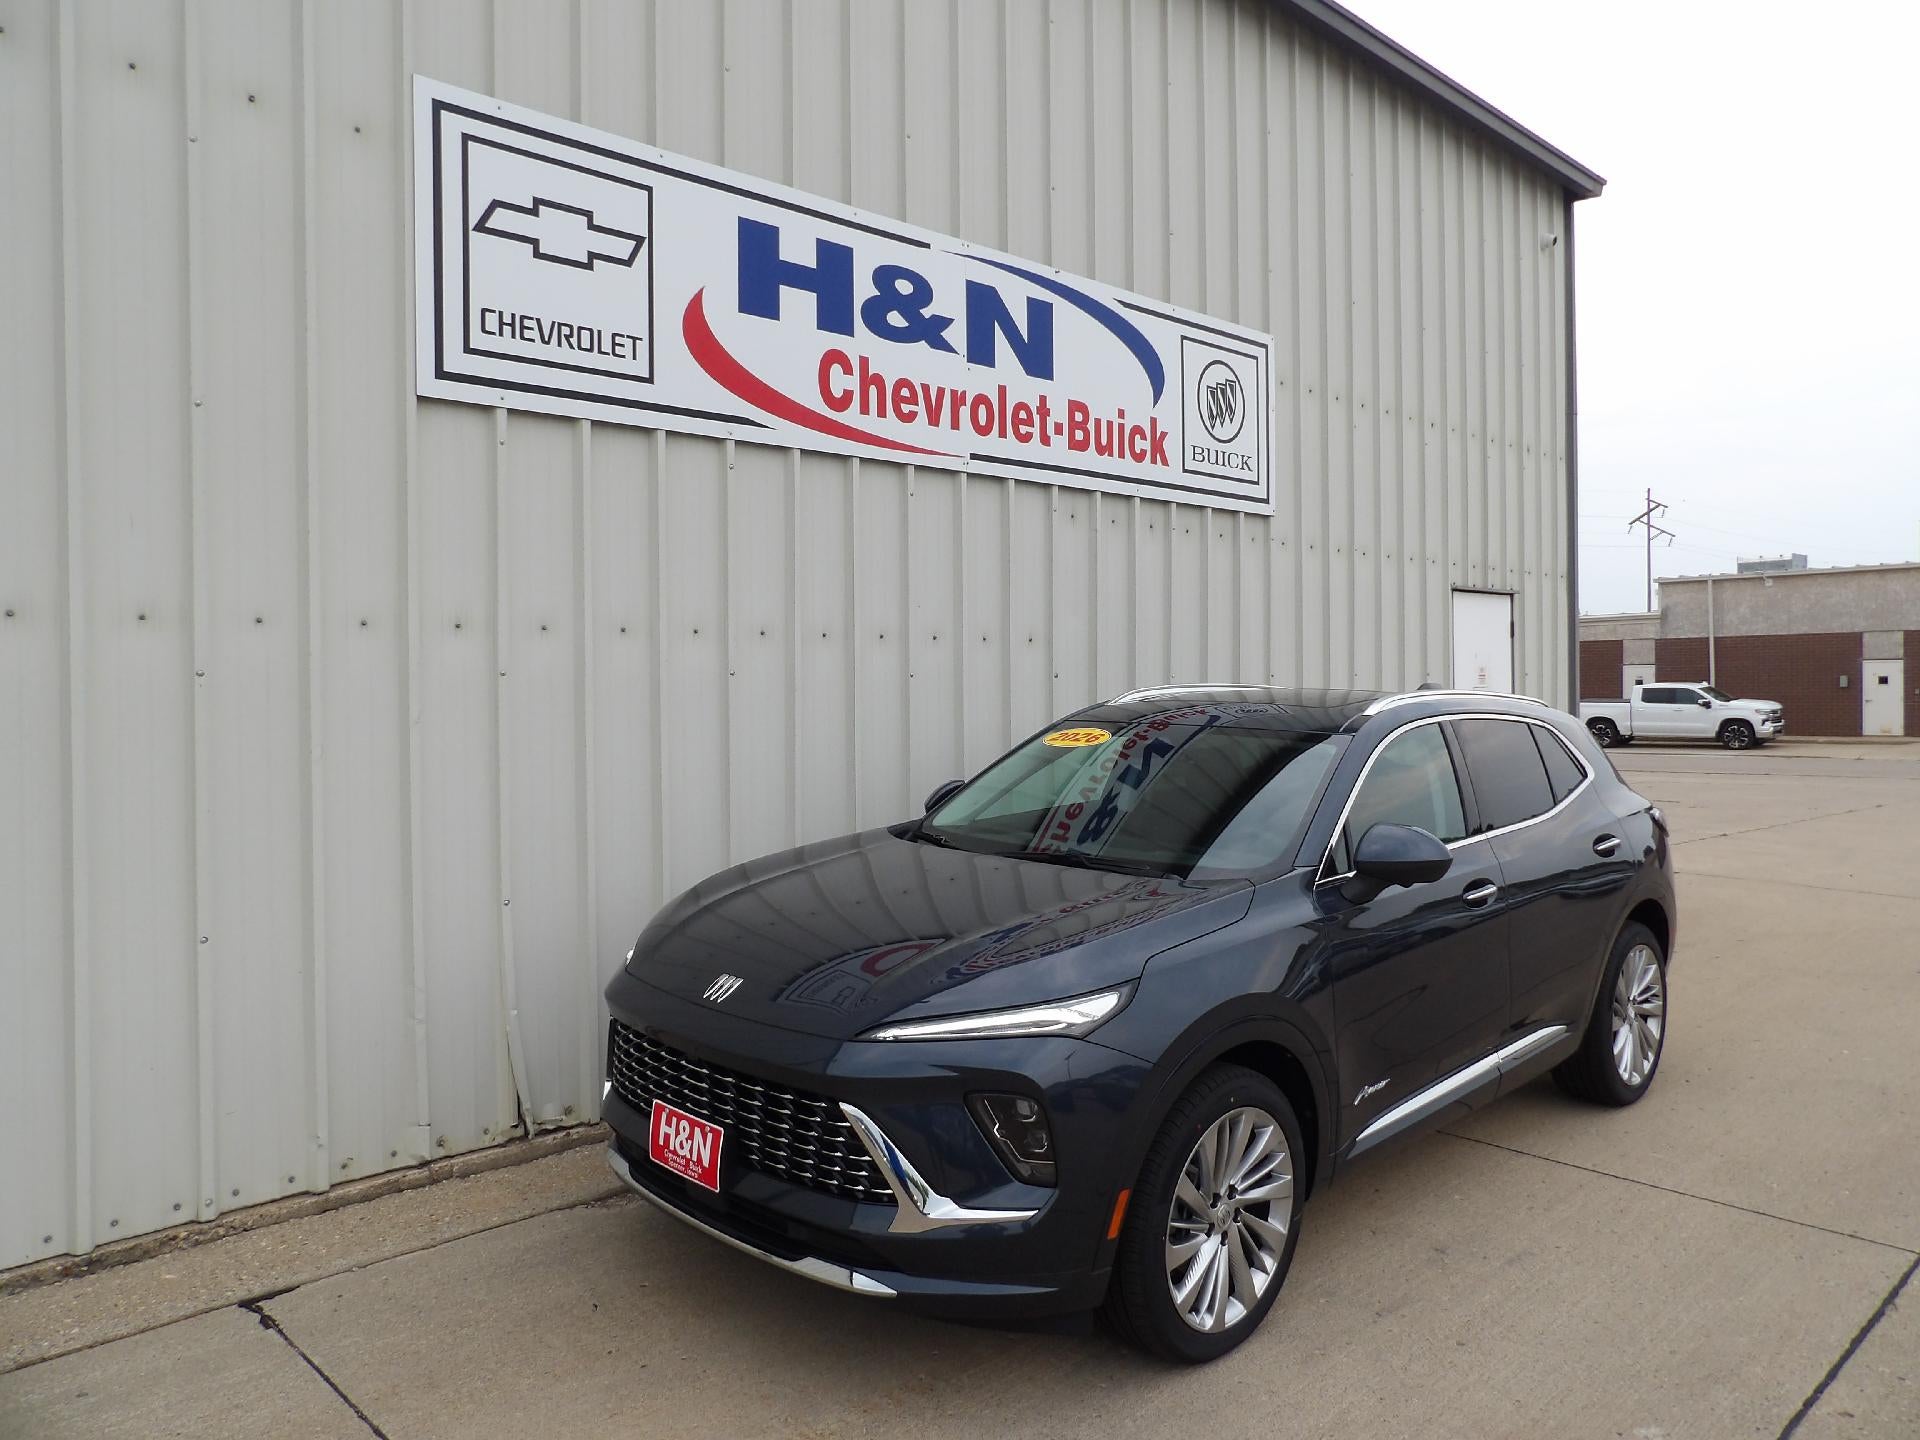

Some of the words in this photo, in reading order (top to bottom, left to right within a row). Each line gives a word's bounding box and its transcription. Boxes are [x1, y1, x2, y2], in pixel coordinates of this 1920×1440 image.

[738, 216, 1054, 381] H&N
[480, 307, 643, 361] CHEVROLET
[1191, 445, 1253, 472] BUICK
[1046, 732, 1105, 743] 2026
[659, 1111, 713, 1168] H&N
